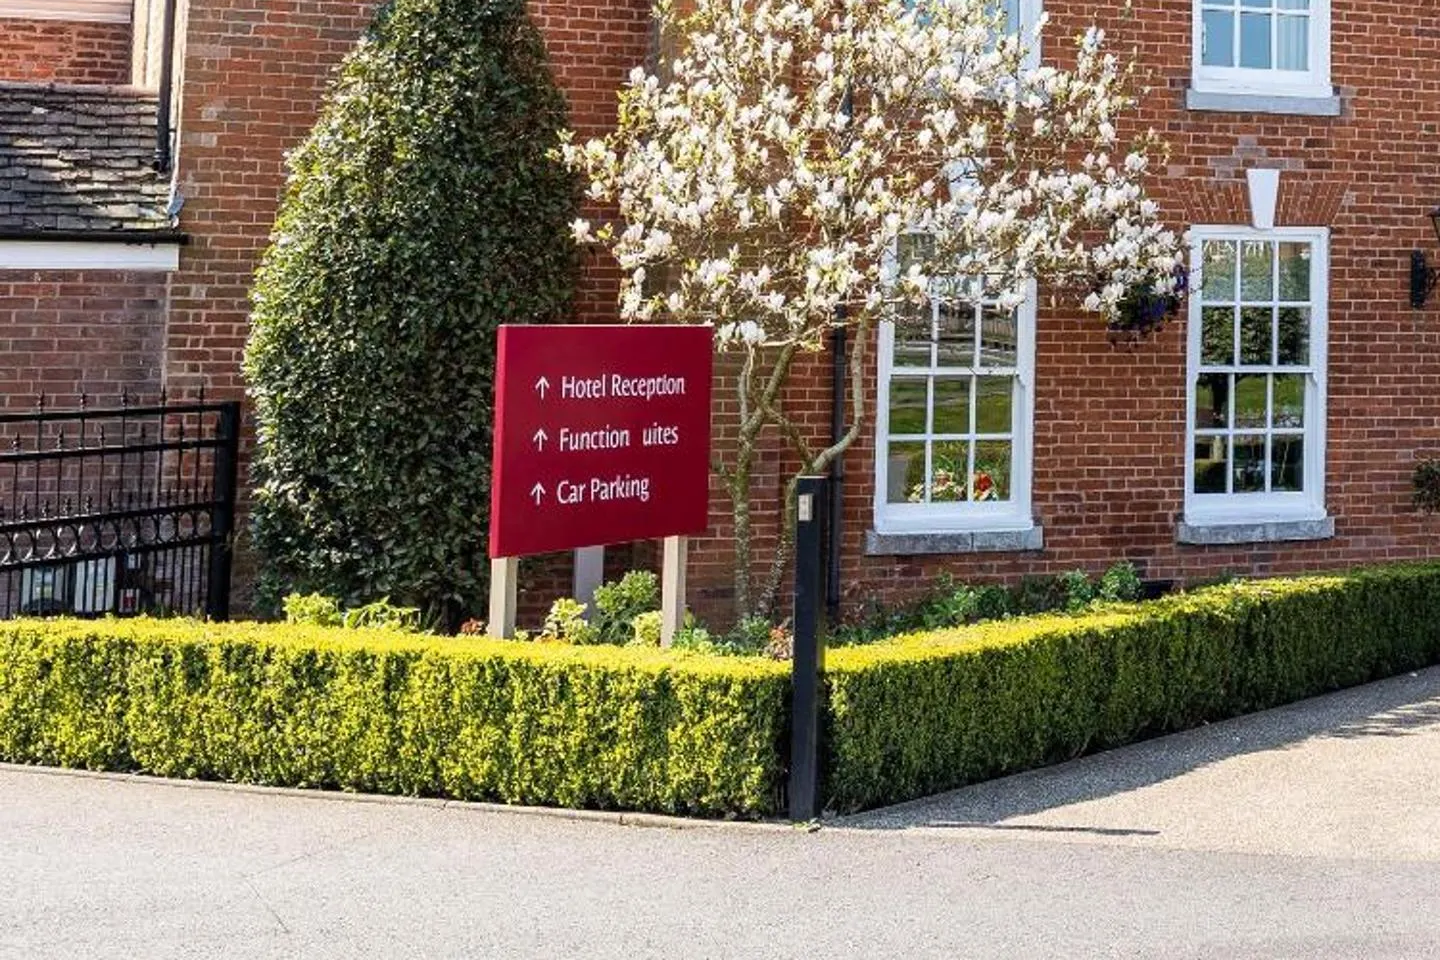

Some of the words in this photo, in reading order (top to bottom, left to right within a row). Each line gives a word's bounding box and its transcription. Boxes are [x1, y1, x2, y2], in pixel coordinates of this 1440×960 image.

[561, 373, 606, 399] Hotel
[611, 373, 686, 401] Reception
[559, 423, 631, 452] Function
[556, 479, 587, 505] Car
[590, 474, 650, 502] Parking
